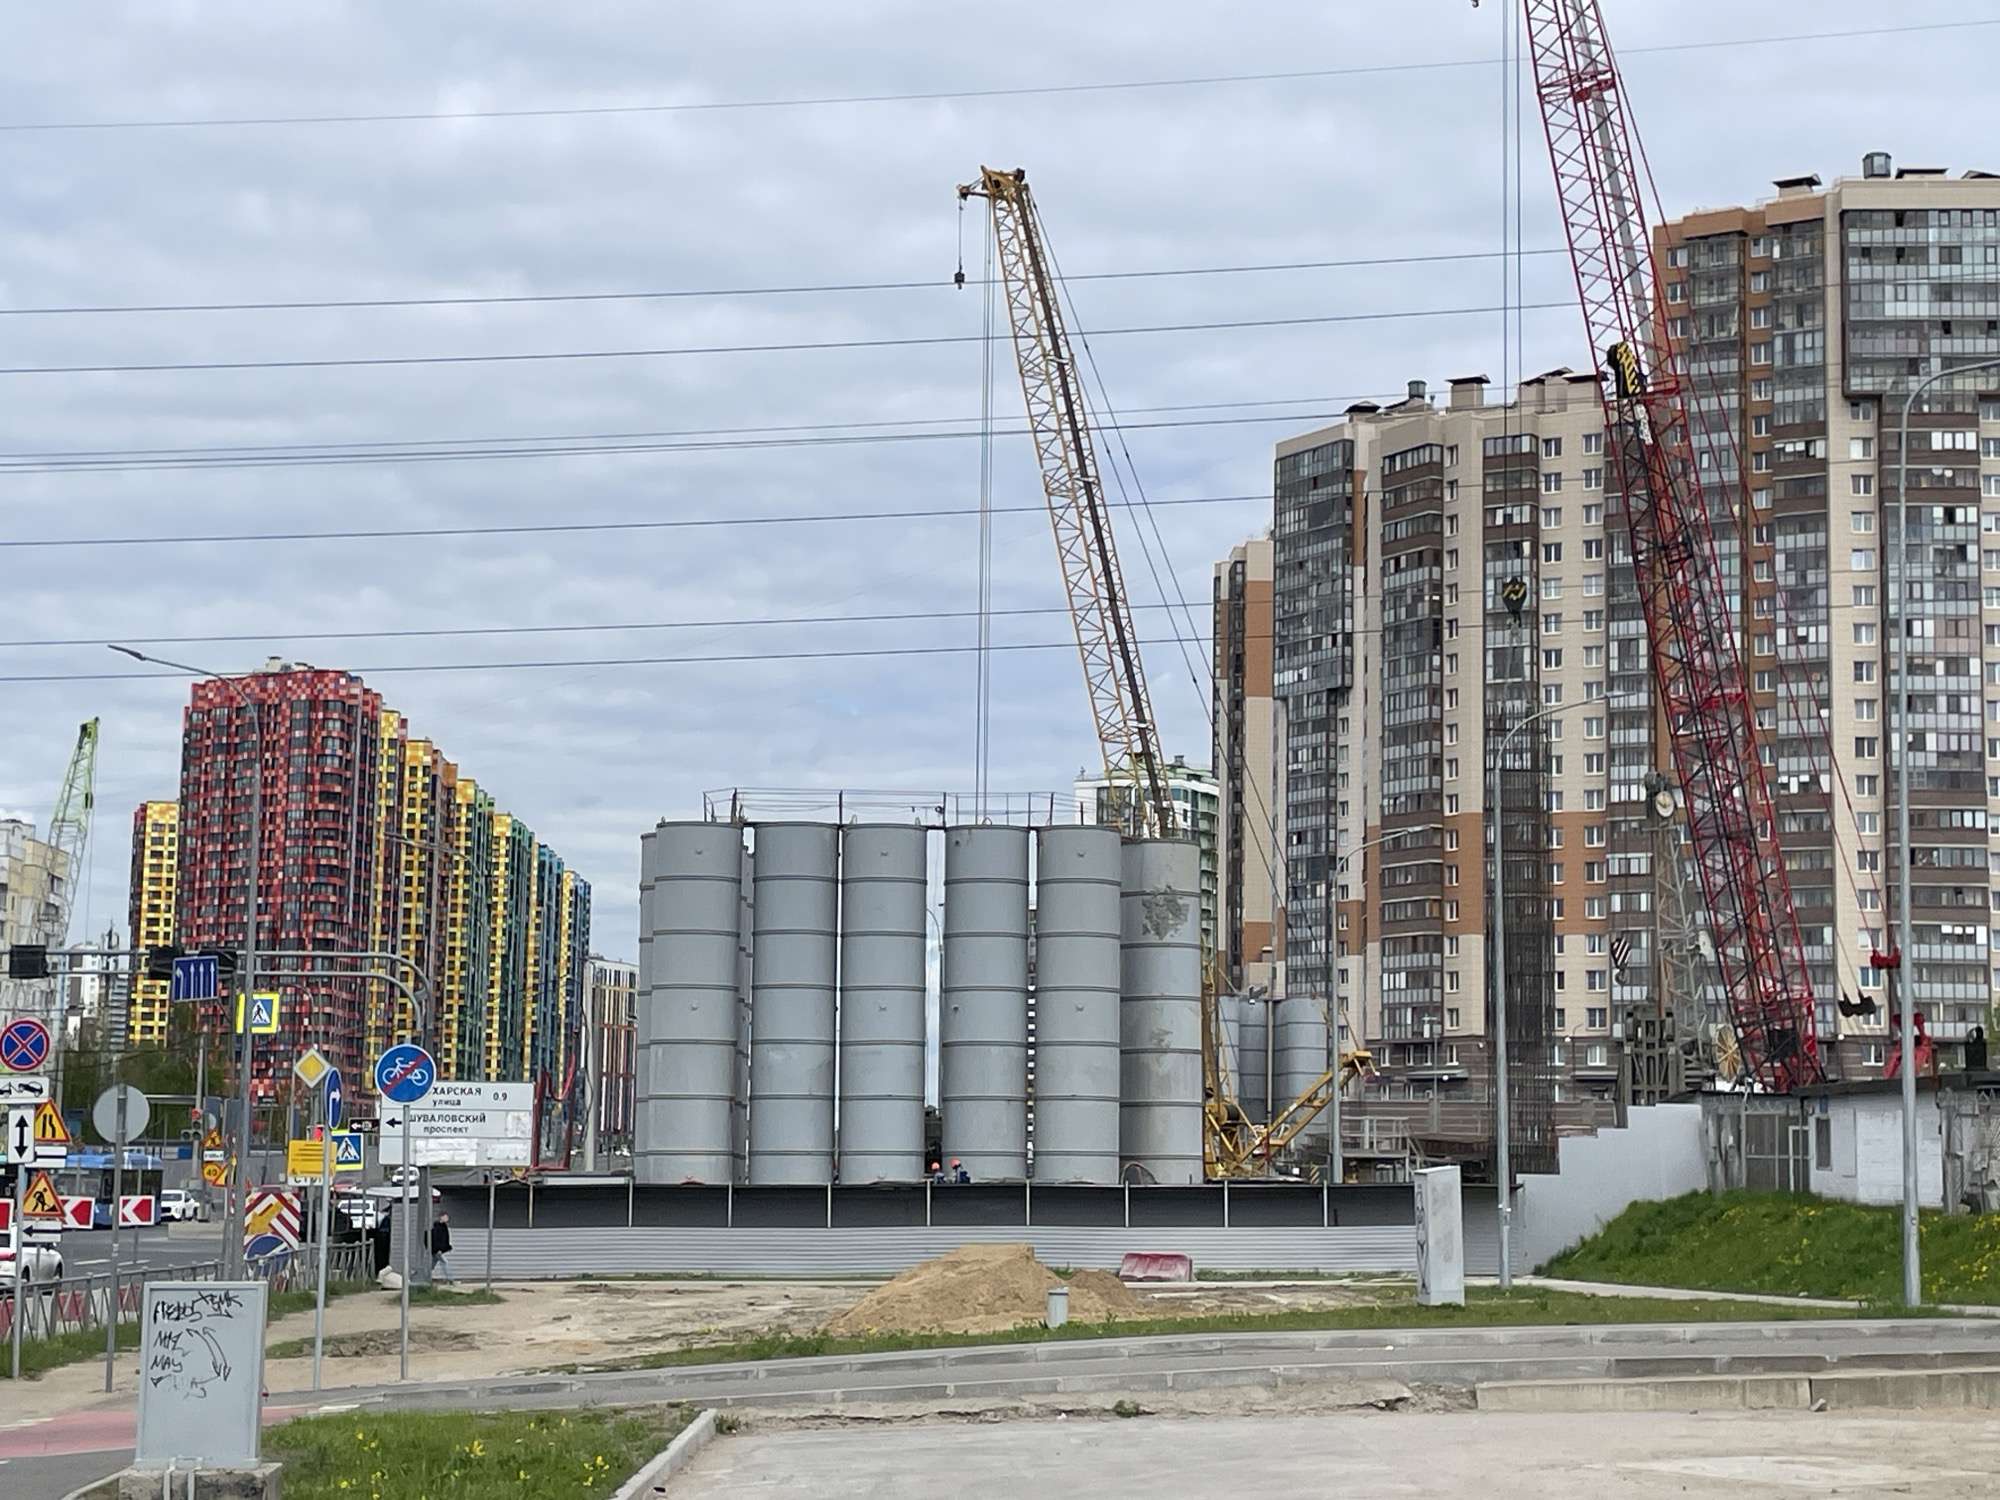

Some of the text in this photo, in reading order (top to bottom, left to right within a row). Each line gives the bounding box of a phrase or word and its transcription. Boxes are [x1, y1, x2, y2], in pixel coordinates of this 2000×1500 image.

[431, 1086, 482, 1096] ХАРСКАЯ
[432, 1098, 462, 1108] улица
[423, 1126, 469, 1135] проспект
